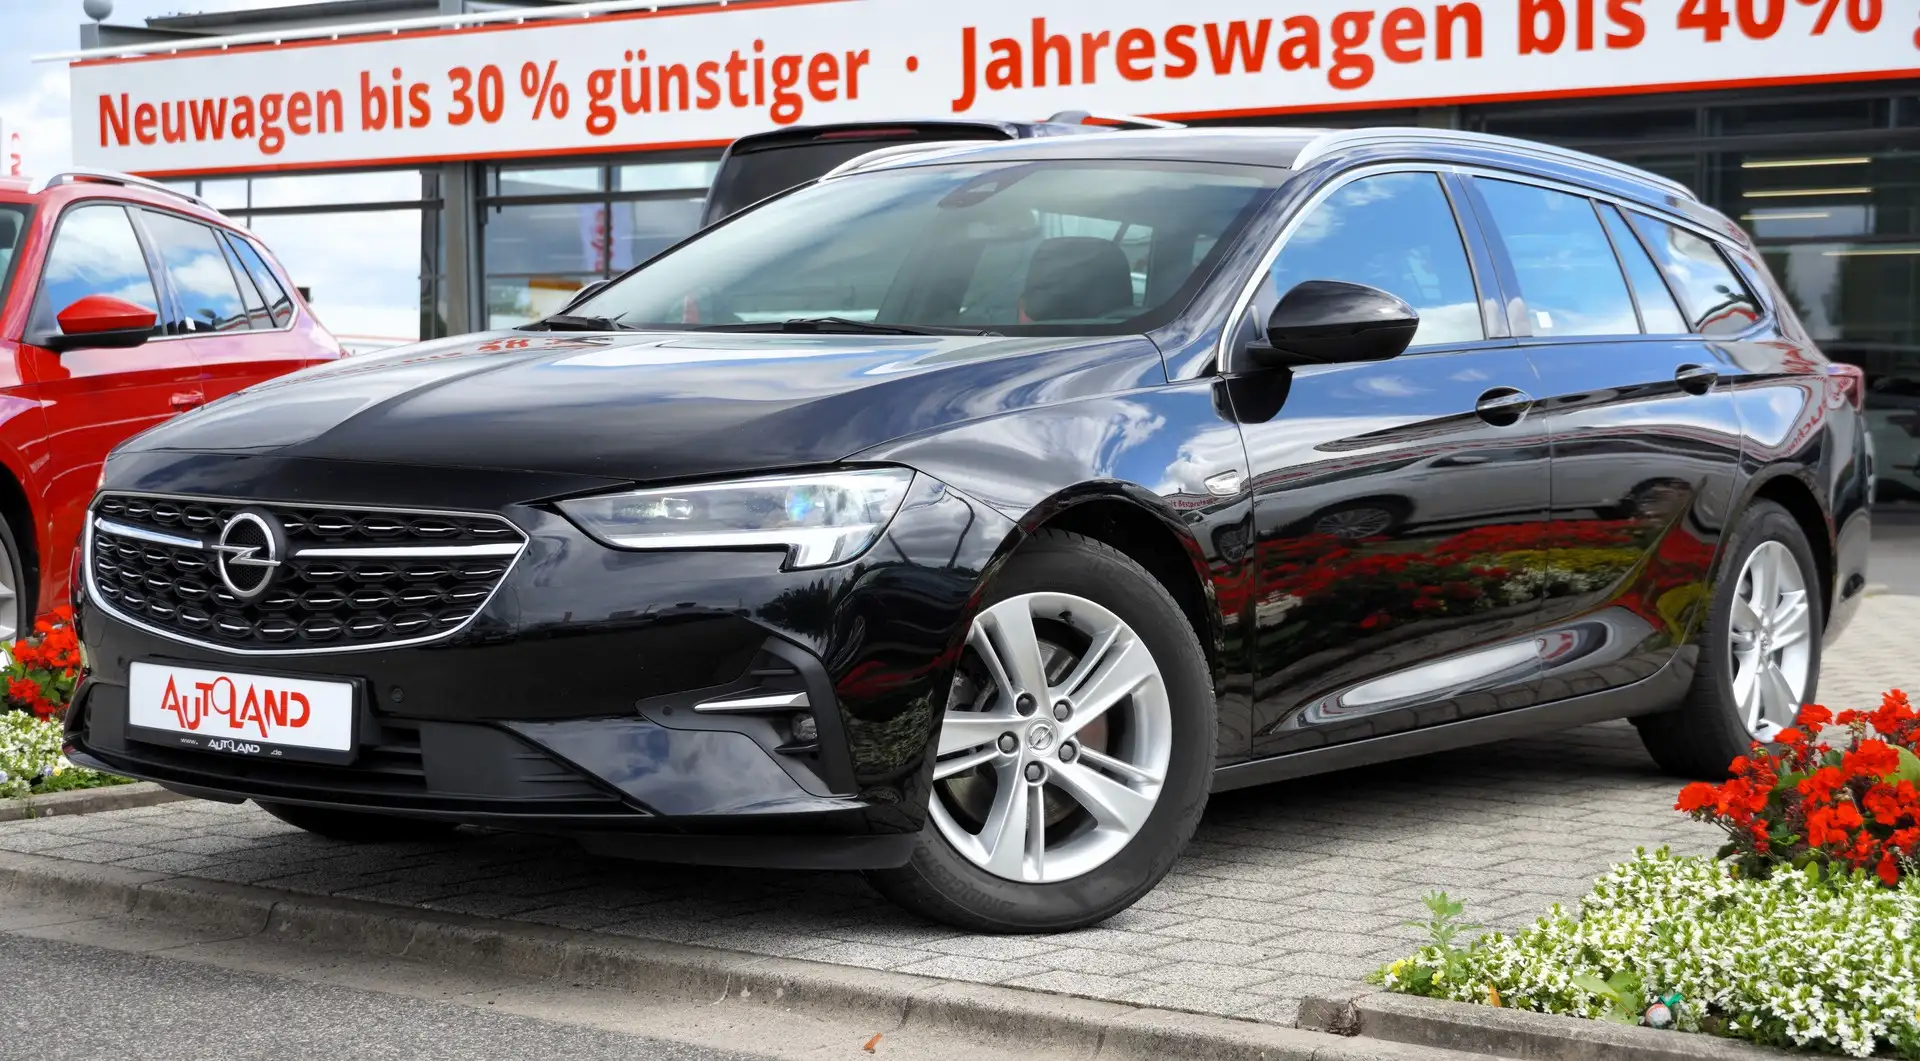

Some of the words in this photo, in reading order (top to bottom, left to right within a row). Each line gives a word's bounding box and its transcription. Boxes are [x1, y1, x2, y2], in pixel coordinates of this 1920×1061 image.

[100, 89, 343, 155] Neuwagen
[361, 67, 431, 132] bis
[447, 64, 504, 126] 30
[520, 60, 569, 120] %
[585, 39, 870, 136] günstiger
[951, 1, 1483, 113] Jahreswagen
[1517, 0, 1647, 56] bis
[161, 673, 311, 739] AUTOLAND
[180, 737, 199, 745] www.
[207, 739, 261, 754] AUTOLAND
